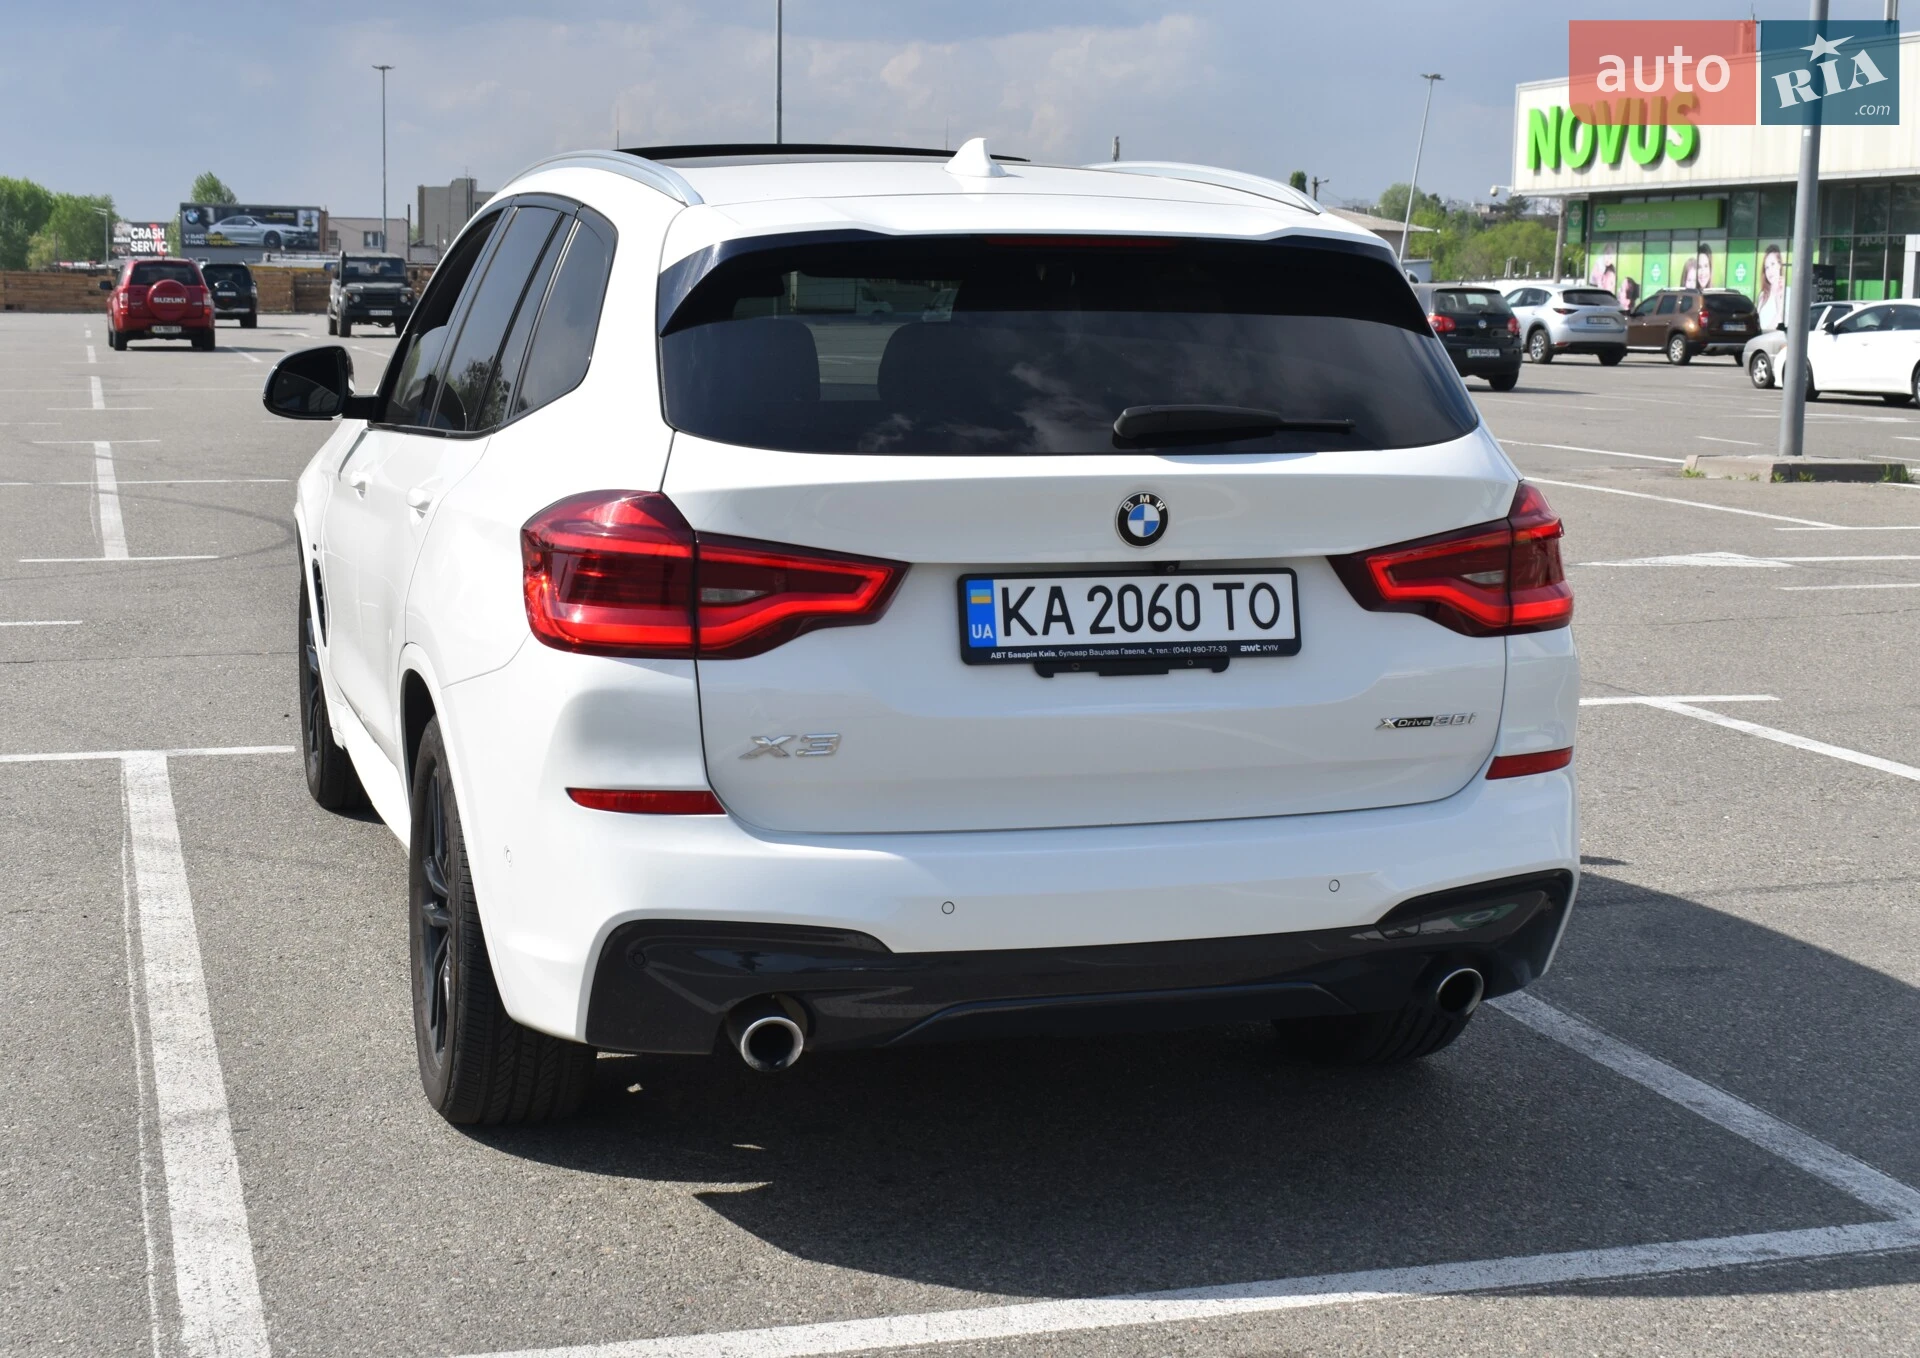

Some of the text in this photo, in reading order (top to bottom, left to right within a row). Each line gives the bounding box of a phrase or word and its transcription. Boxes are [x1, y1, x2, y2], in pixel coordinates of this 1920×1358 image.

[1527, 92, 1699, 170] NOVUS
[130, 227, 165, 240] CRASH
[1123, 494, 1166, 512] BMW
[1001, 582, 1281, 637] KA 2060 TO
[971, 623, 994, 640] UA
[990, 651, 1006, 659] АВТ
[1058, 649, 1088, 659] бульвар
[1088, 648, 1120, 657] Вацлава
[1172, 645, 1192, 655] (044)
[1192, 645, 1228, 654] 490-77-33
[1240, 644, 1279, 652] awt KYIV
[738, 733, 842, 760] X3
